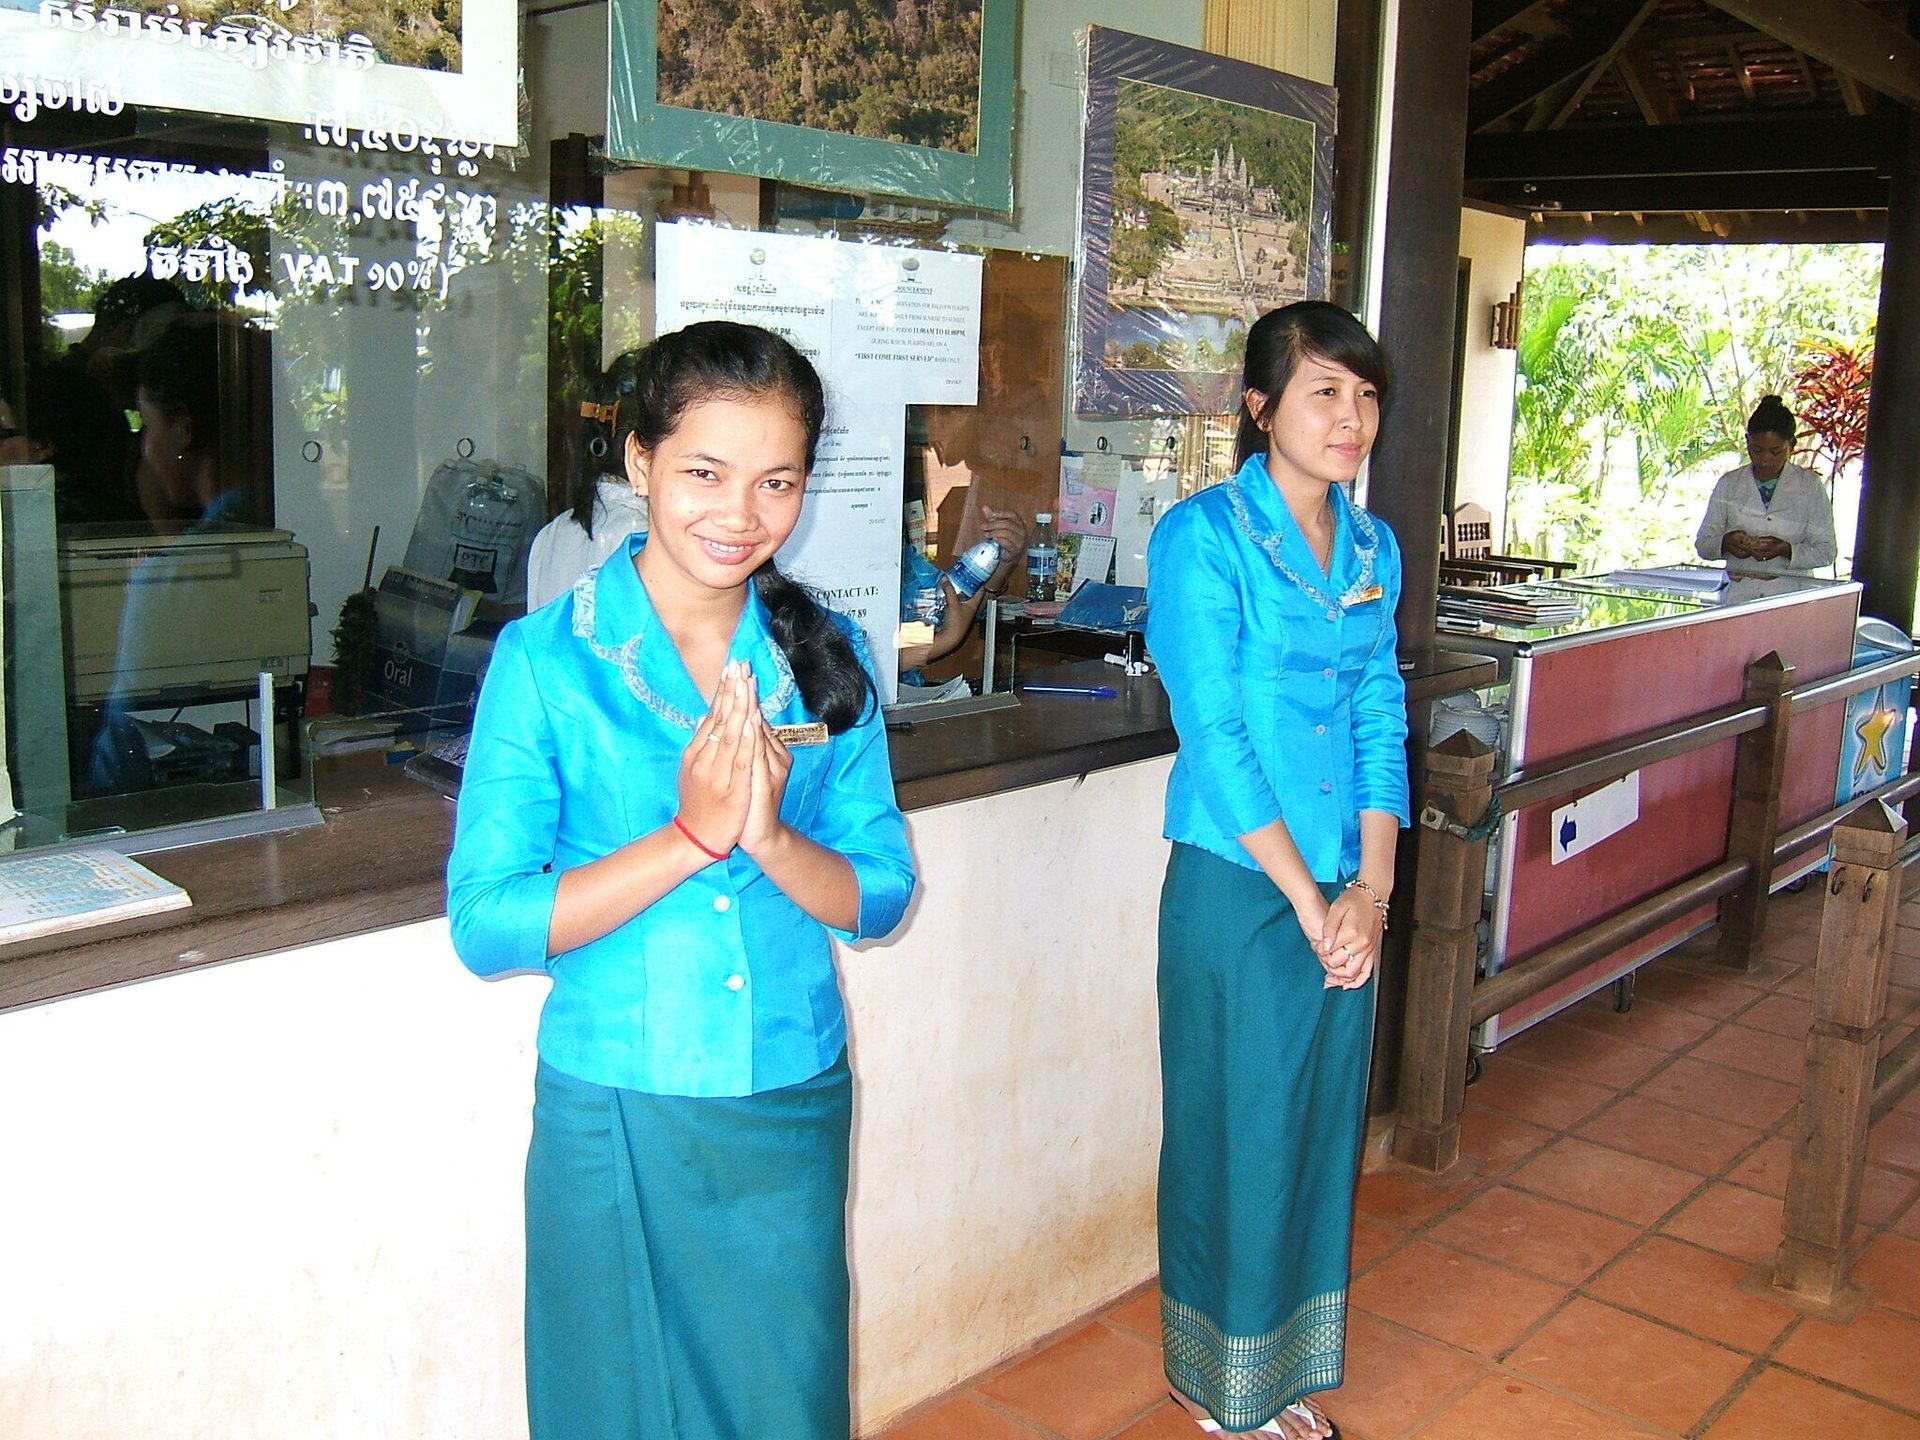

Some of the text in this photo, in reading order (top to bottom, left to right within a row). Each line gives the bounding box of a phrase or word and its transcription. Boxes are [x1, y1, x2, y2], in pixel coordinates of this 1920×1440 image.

[281, 253, 360, 291] VAT
[816, 586, 879, 600] CONTACT AT:
[384, 660, 413, 687] Oral
